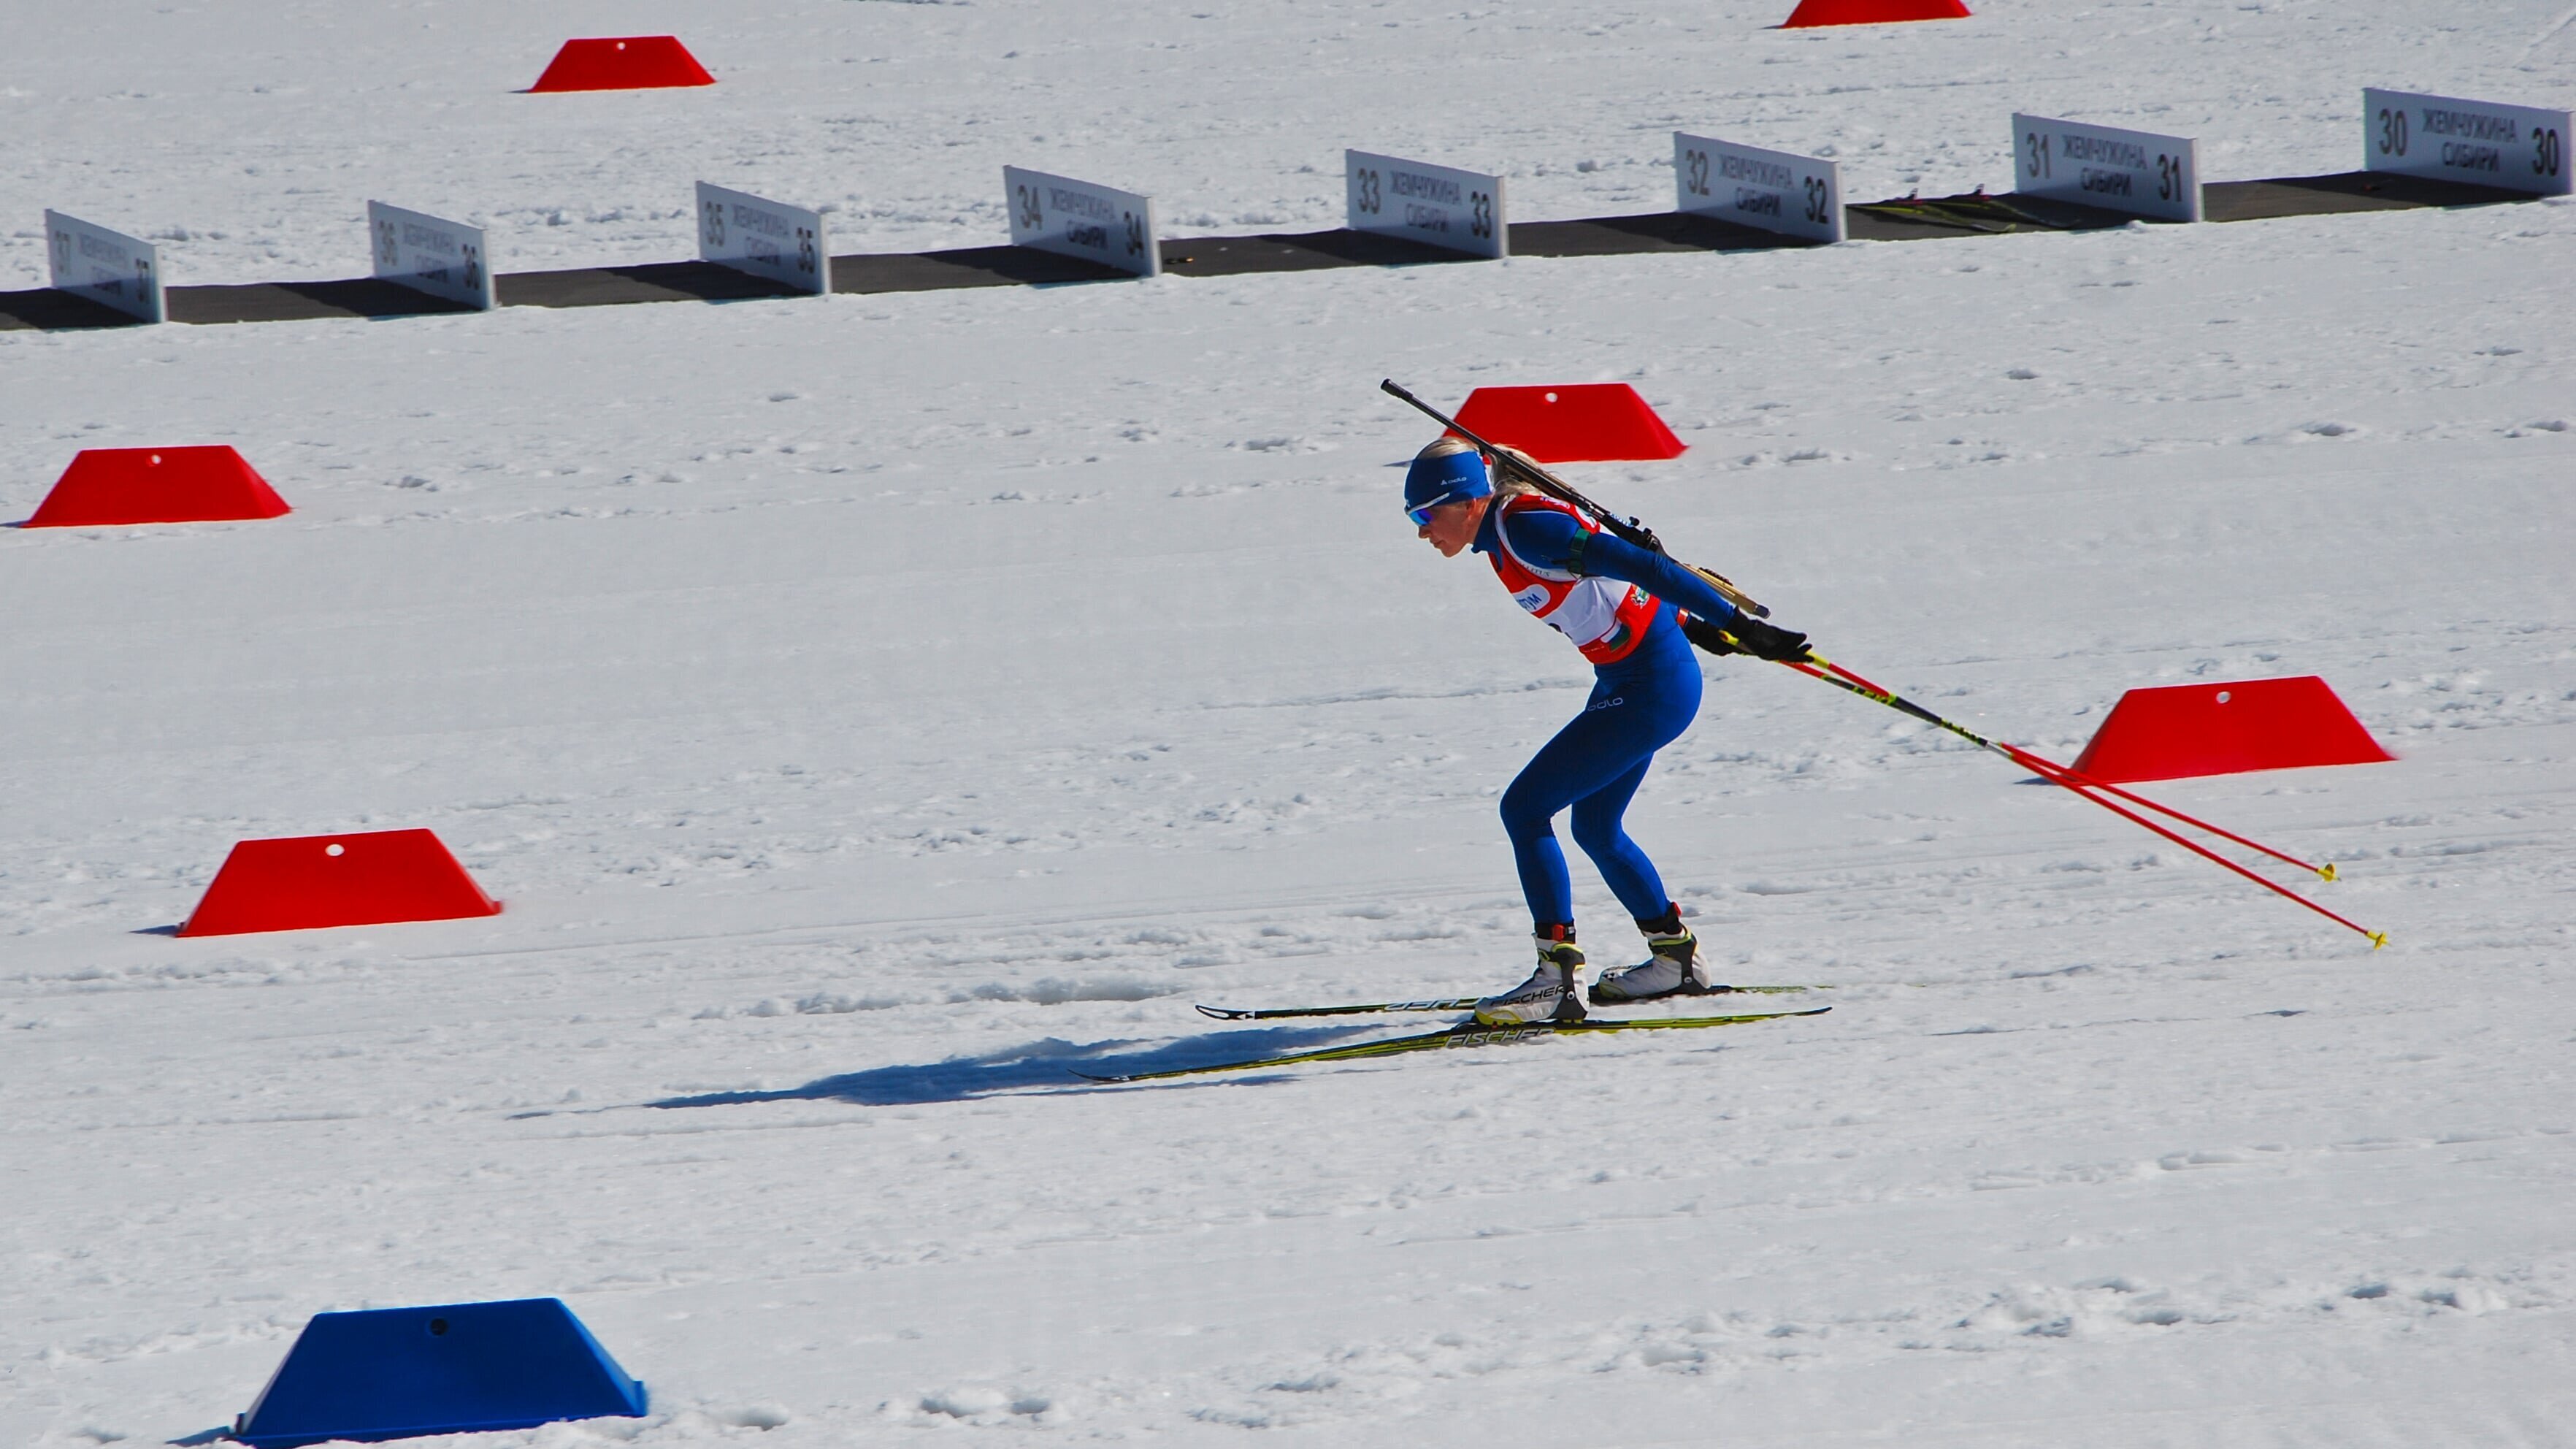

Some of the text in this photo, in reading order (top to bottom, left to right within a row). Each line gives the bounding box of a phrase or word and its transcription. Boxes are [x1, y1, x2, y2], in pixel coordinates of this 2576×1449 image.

[2379, 109, 2408, 156] 30
[2422, 109, 2517, 143] ЖЕМЧУЖИНА
[1686, 150, 1710, 196] 32
[2027, 132, 2051, 186] 31
[2063, 134, 2147, 169] ЖЕМЧУЖИНА
[2442, 142, 2500, 172] СИБИРИ
[2532, 127, 2560, 176] 30
[1357, 167, 1381, 215] 33
[1804, 175, 1830, 224] 32
[2158, 154, 2183, 202] 31
[705, 201, 726, 247] 35
[1017, 184, 1043, 231] 34
[1471, 191, 1492, 240] 33
[795, 227, 816, 274] 35
[1123, 211, 1143, 259] 34
[1587, 697, 1623, 711] odlo
[1490, 985, 1565, 1007] FISCHER
[1444, 1027, 1555, 1047] FISCHER
